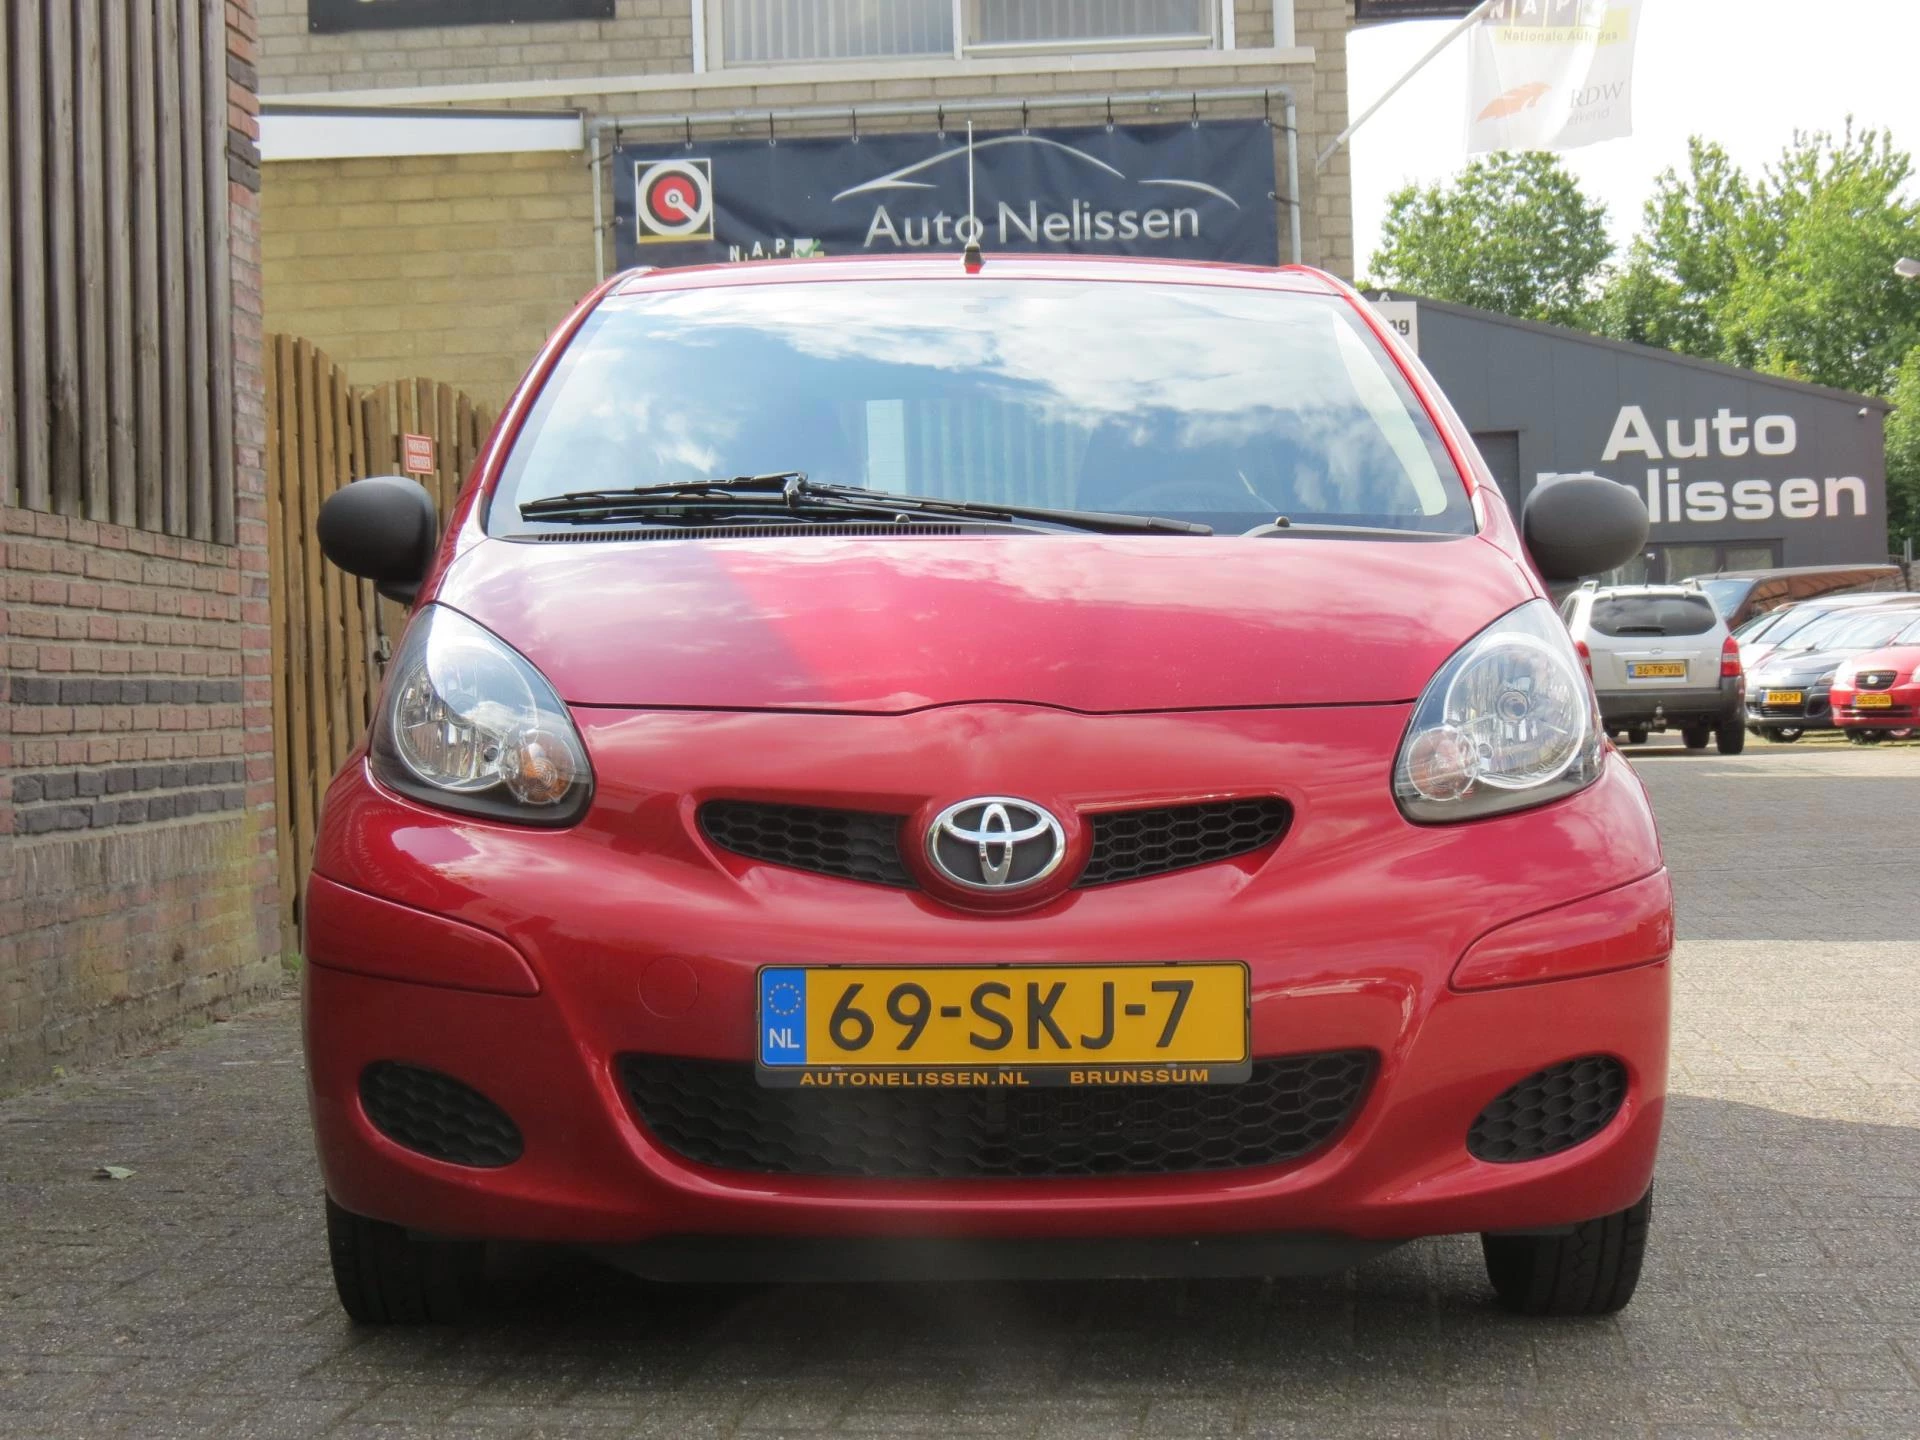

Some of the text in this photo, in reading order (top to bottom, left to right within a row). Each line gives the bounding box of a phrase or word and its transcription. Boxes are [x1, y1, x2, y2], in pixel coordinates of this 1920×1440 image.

[1504, 29, 1563, 42] Nationale
[1570, 80, 1625, 109] RDW
[863, 199, 1200, 247] Auto Nelissen
[1601, 405, 1797, 461] Auto
[1536, 467, 1868, 523] lissen
[828, 980, 1195, 1052] 69-SKJ-7
[769, 1028, 800, 1049] NL
[799, 1068, 1210, 1087] AUTONELISSEN.NL BRUNSSUM
